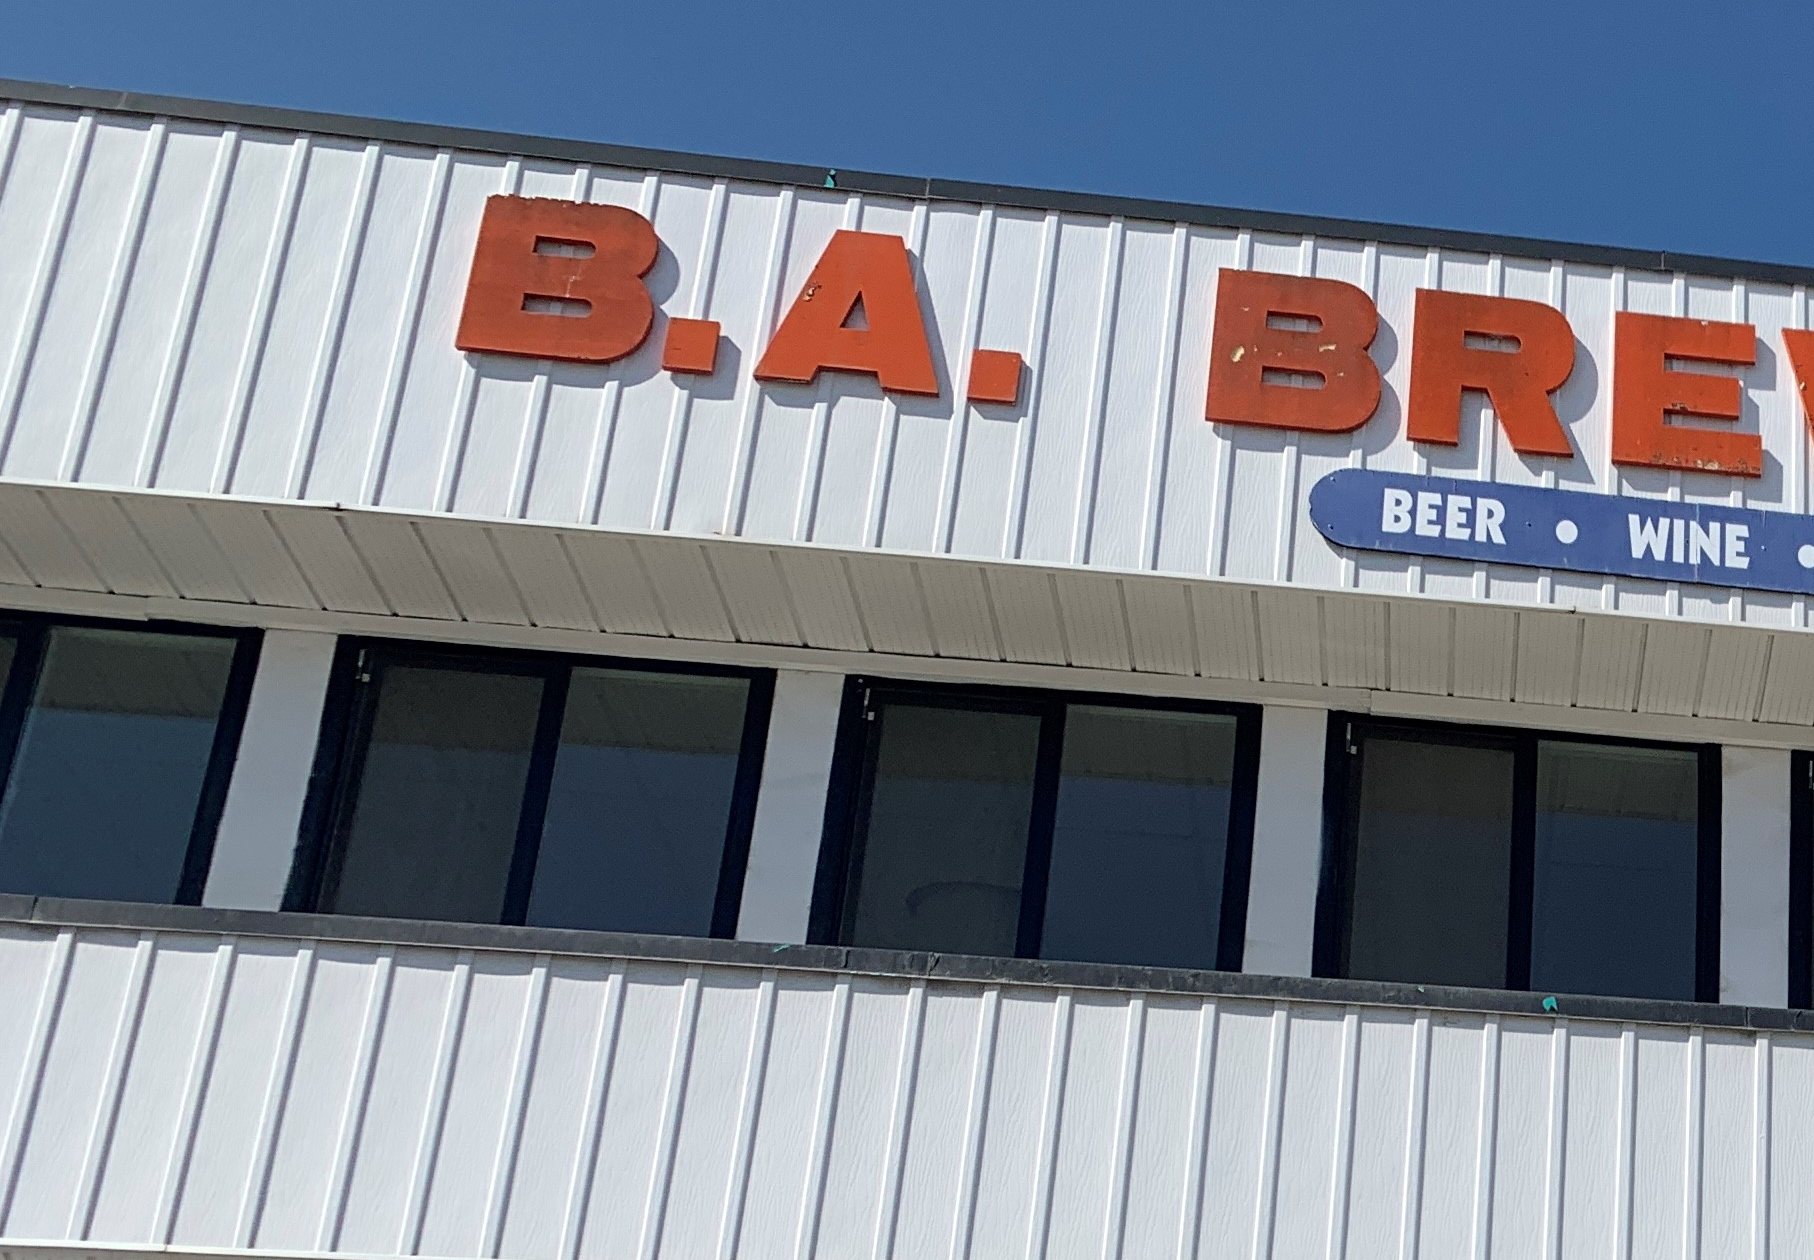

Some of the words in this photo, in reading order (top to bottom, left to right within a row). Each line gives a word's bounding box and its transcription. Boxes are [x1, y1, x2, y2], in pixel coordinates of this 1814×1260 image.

[455, 193, 1023, 404] B.A.
[1381, 487, 1506, 545] BEER
[1628, 513, 1750, 569] WINE
